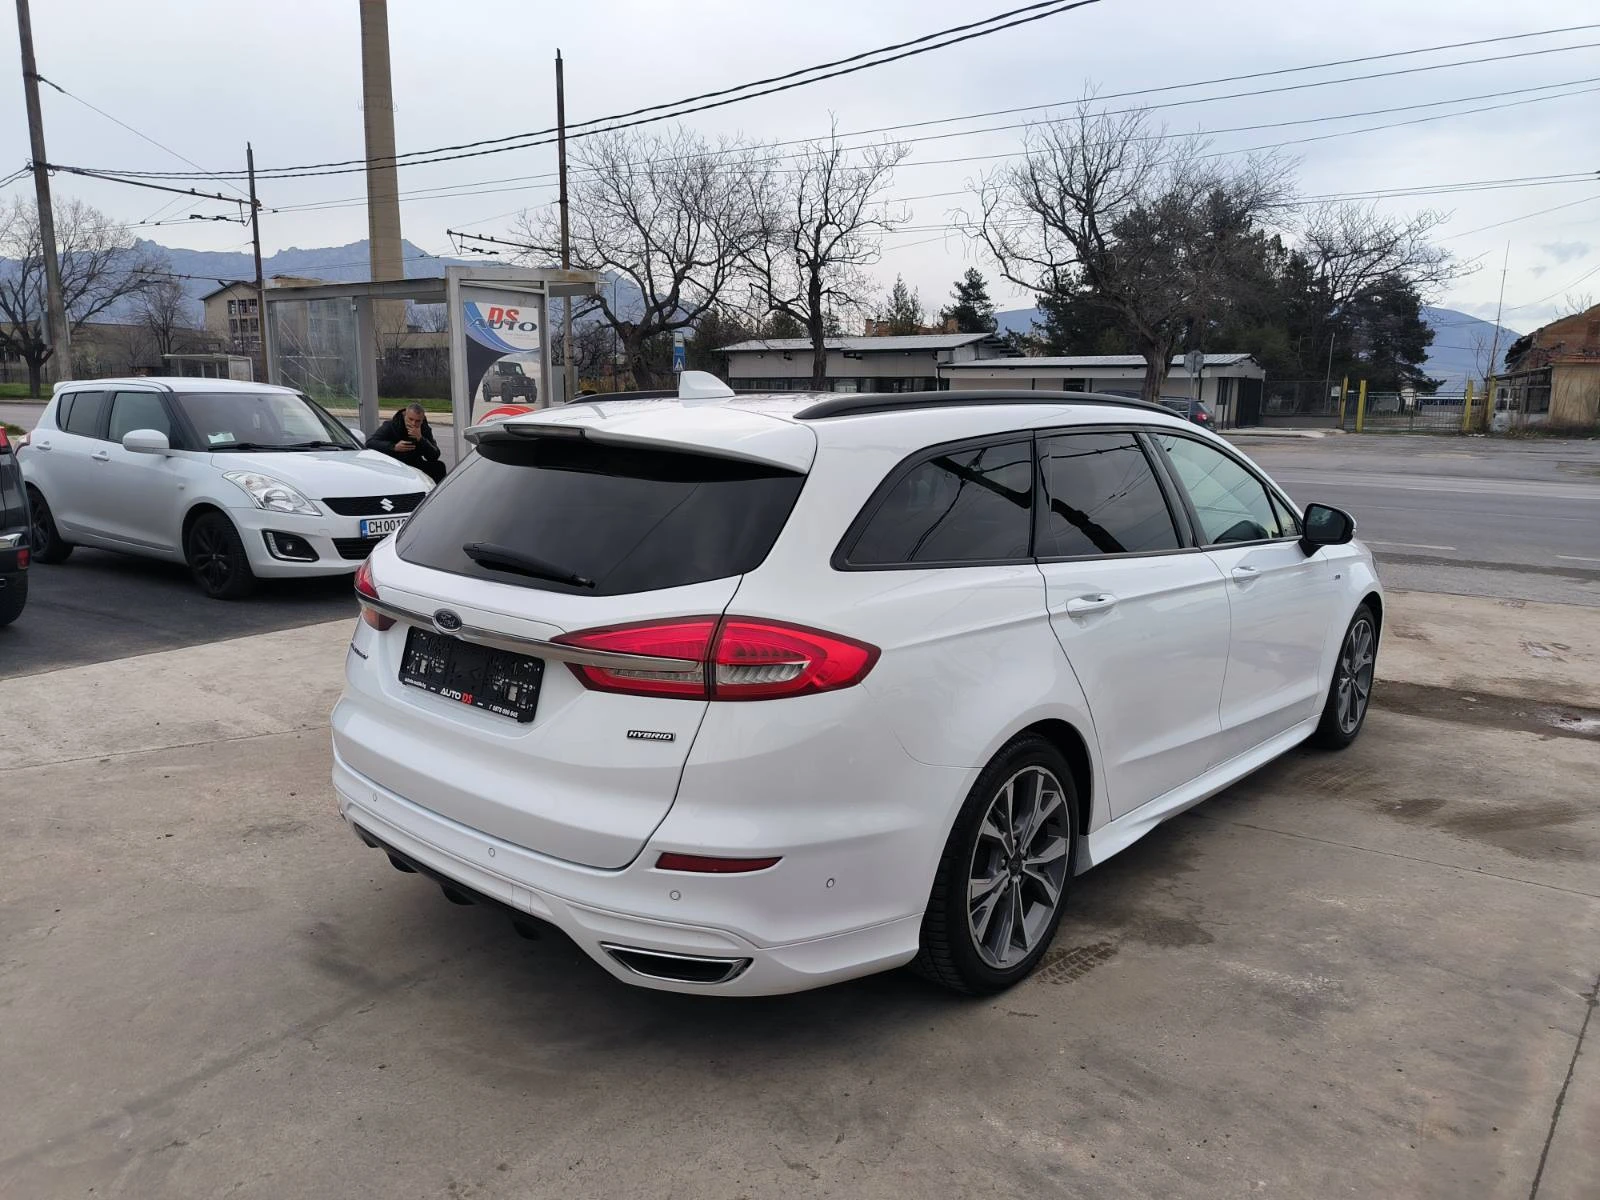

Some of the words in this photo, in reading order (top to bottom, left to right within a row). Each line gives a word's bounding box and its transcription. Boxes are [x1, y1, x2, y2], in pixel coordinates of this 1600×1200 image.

[488, 307, 519, 323] DS
[468, 319, 537, 332] AUTO
[440, 687, 461, 700] AUTO
[462, 692, 473, 704] DS
[629, 731, 672, 740] HYBRID
